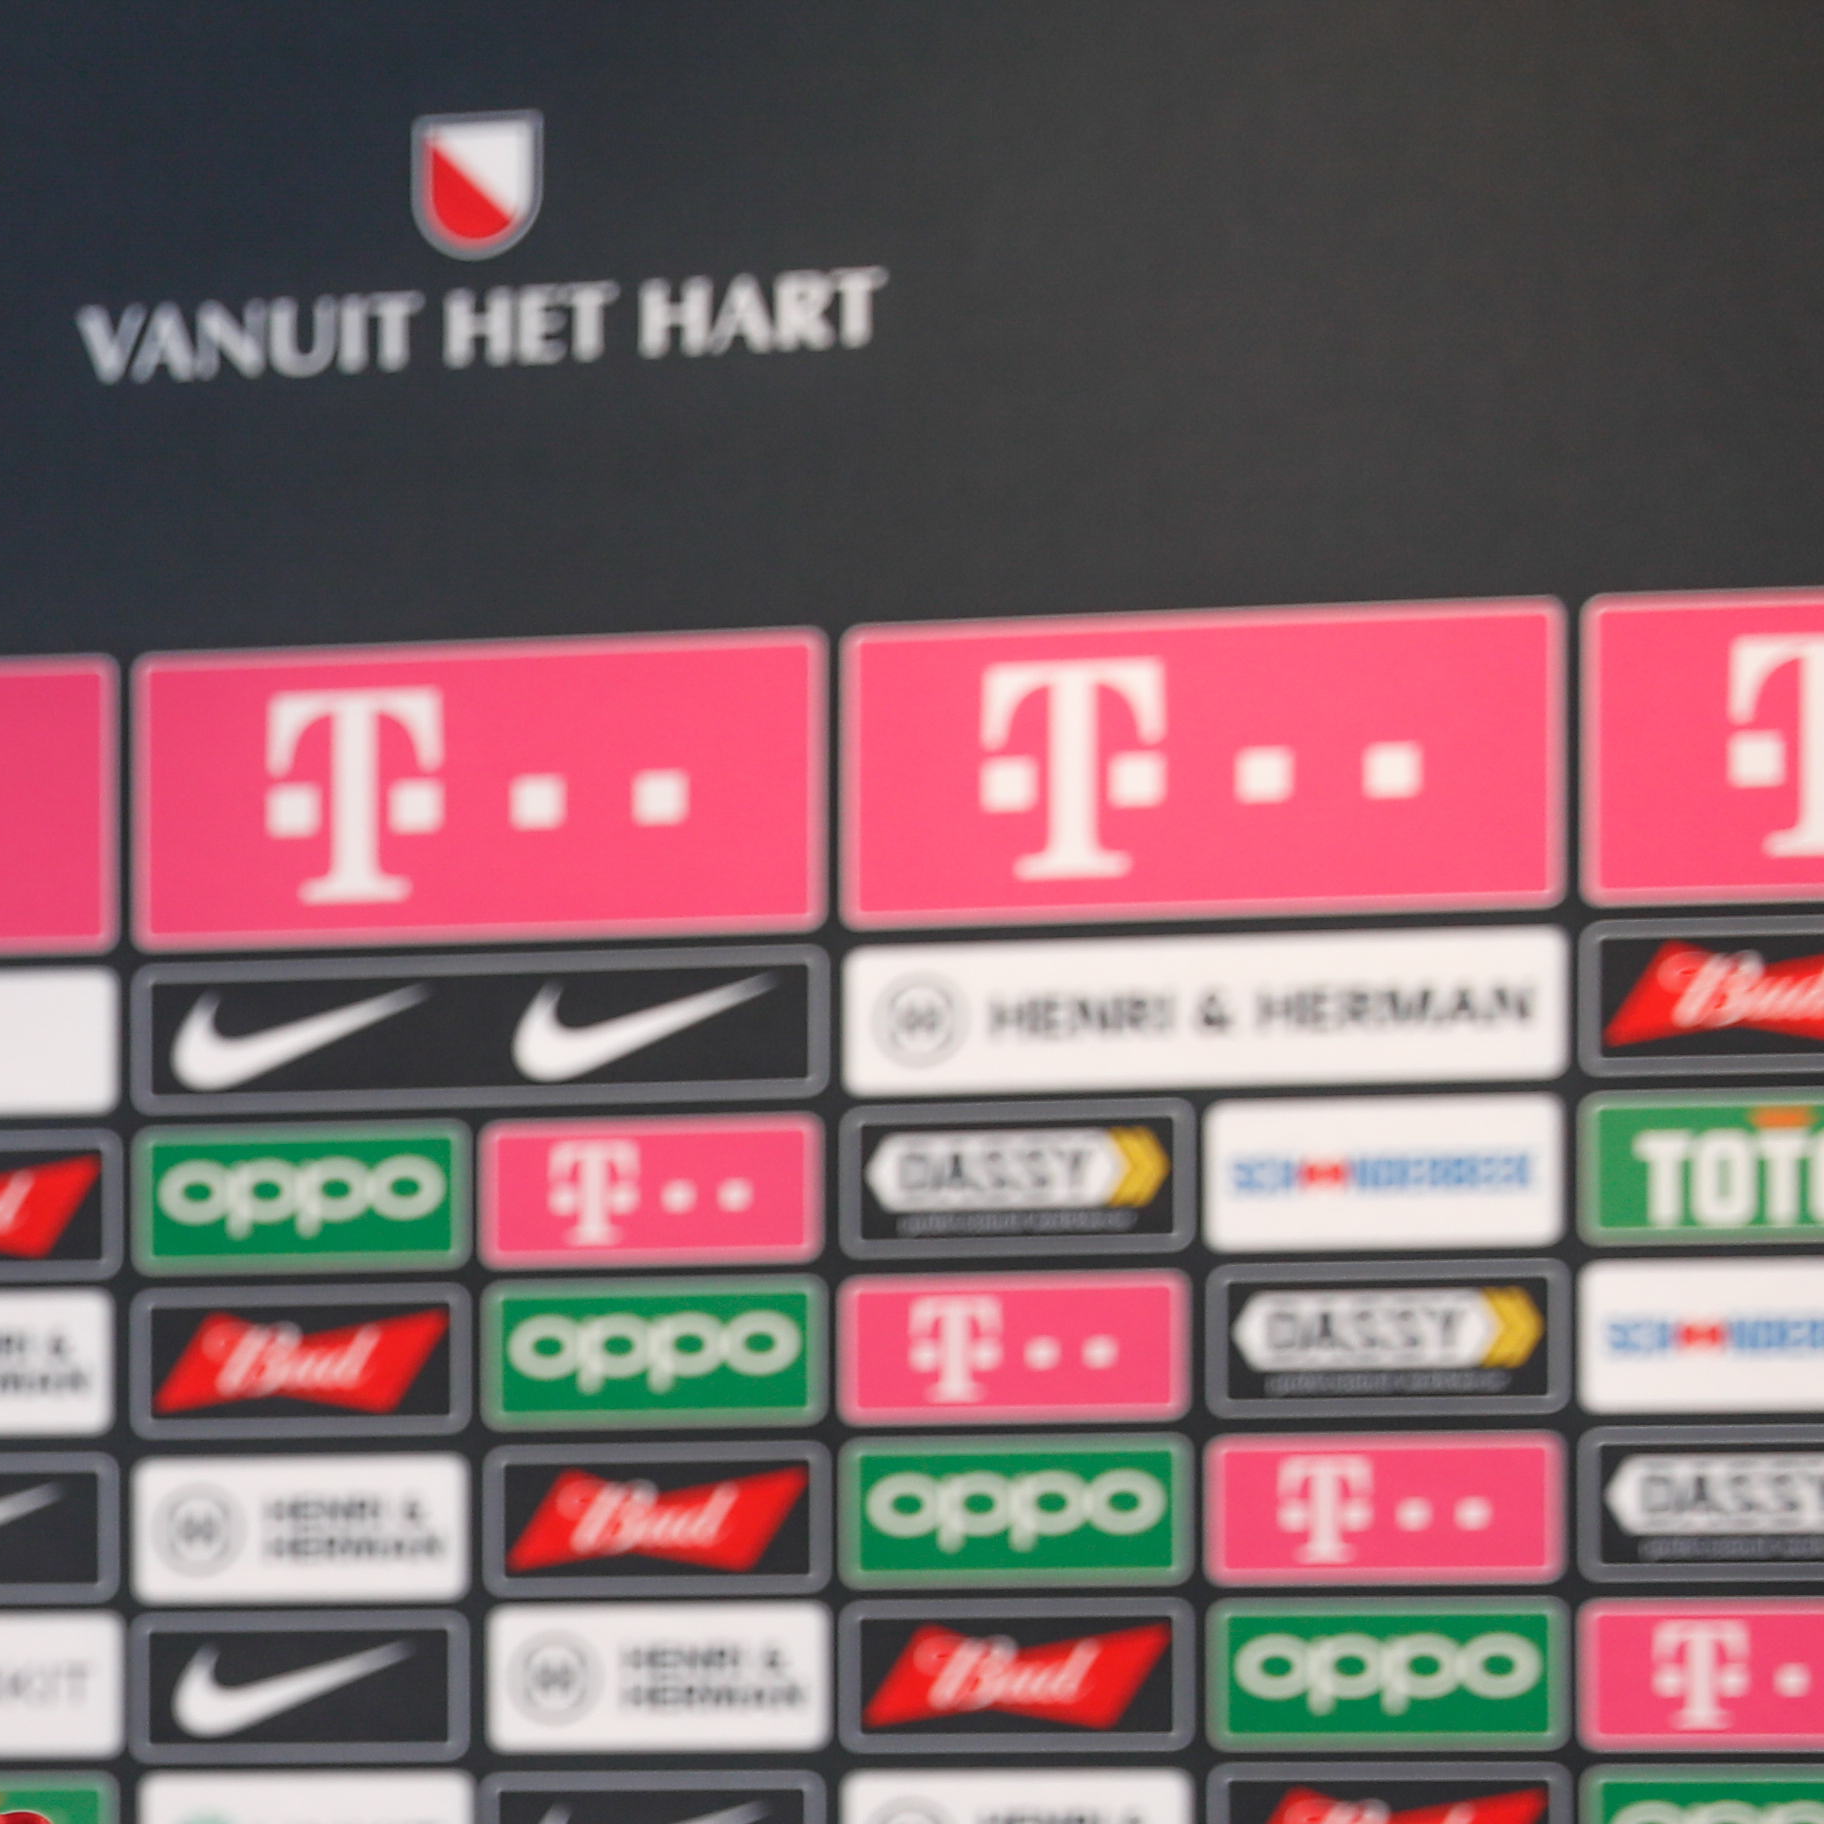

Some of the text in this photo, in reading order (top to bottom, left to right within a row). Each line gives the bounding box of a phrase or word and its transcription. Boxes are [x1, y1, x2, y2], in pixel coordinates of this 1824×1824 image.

[76, 264, 889, 385] VANUIT HET HART
[988, 978, 1540, 1042] HENRI & HERMAN
[156, 1153, 447, 1241] oppo
[896, 1144, 1095, 1192] DASSY
[1630, 1122, 1824, 1231] TOT
[506, 1309, 803, 1397] oppo
[1263, 1304, 1467, 1352] DASSY
[864, 1467, 1168, 1555] oppo
[1232, 1629, 1543, 1718] oppo
